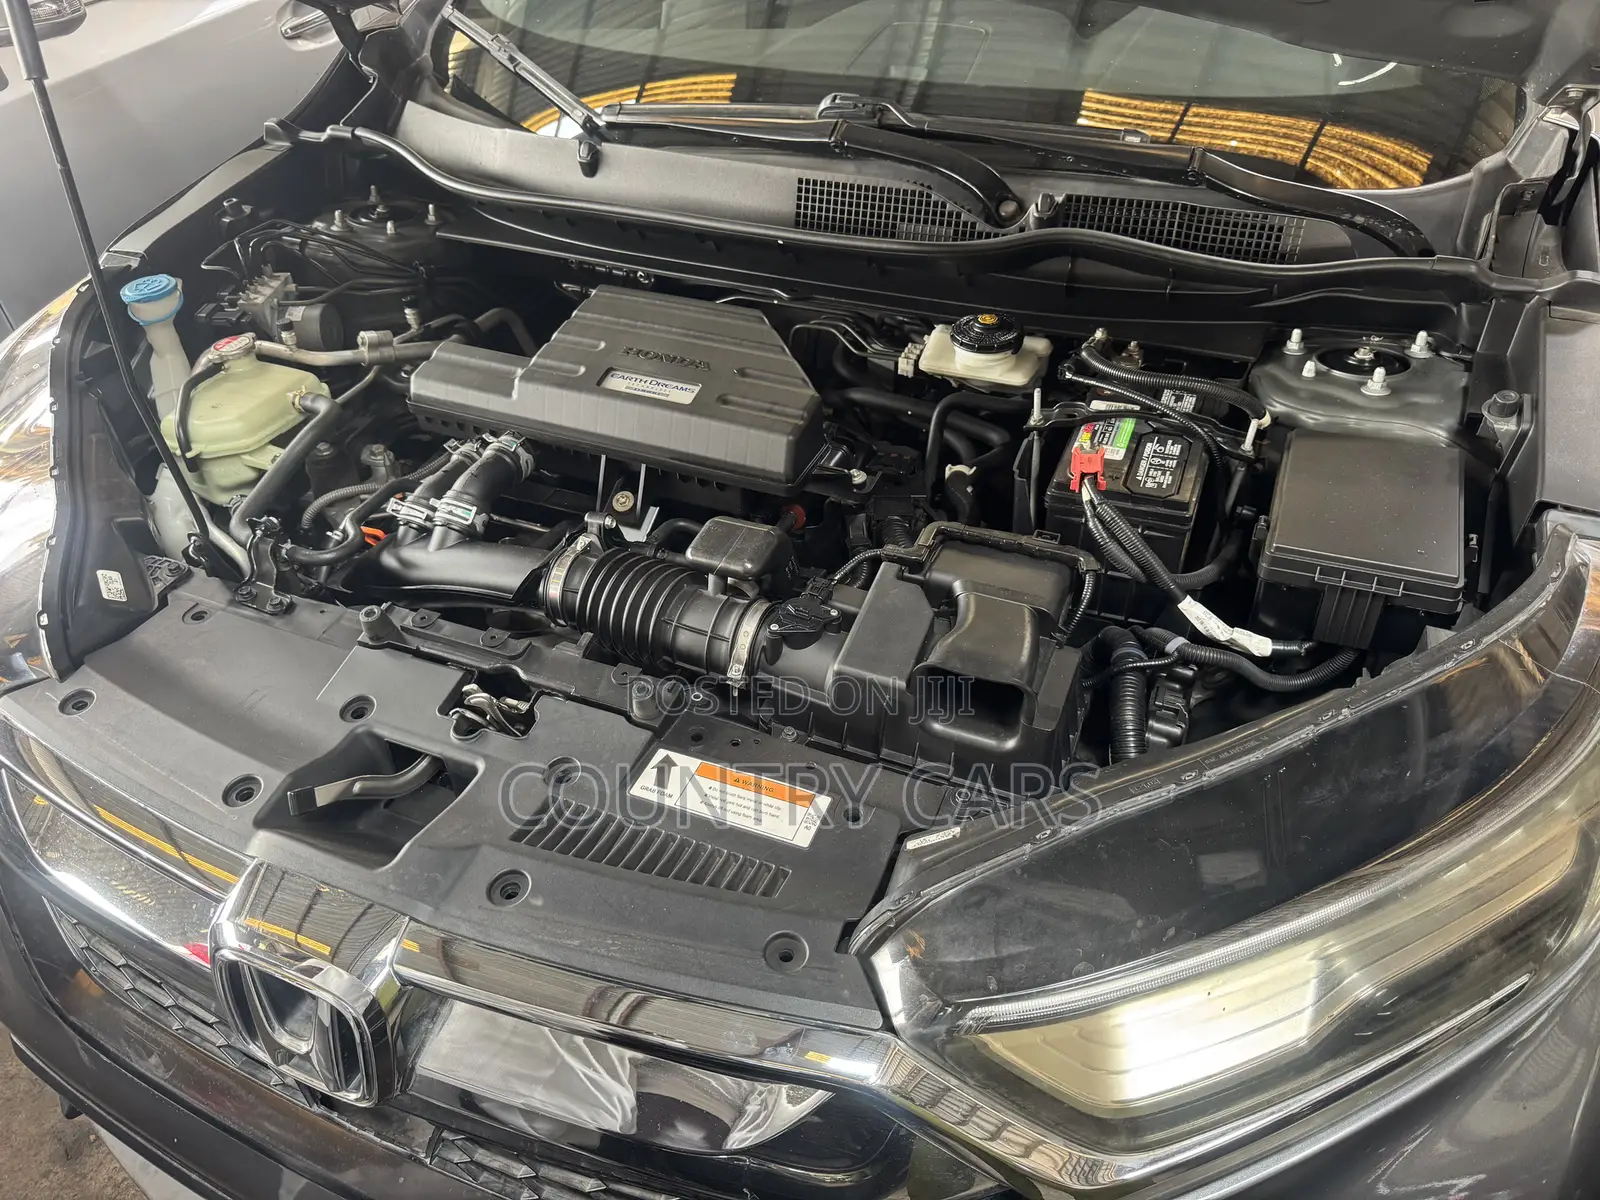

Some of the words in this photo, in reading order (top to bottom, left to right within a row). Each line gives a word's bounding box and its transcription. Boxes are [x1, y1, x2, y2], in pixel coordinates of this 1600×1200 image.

[621, 346, 711, 372] HONDA
[610, 372, 648, 385] EARTH
[649, 379, 697, 394] DREAMS
[640, 784, 657, 794] GRAB
[656, 791, 674, 799] FOAM
[742, 780, 774, 793] WARNING
